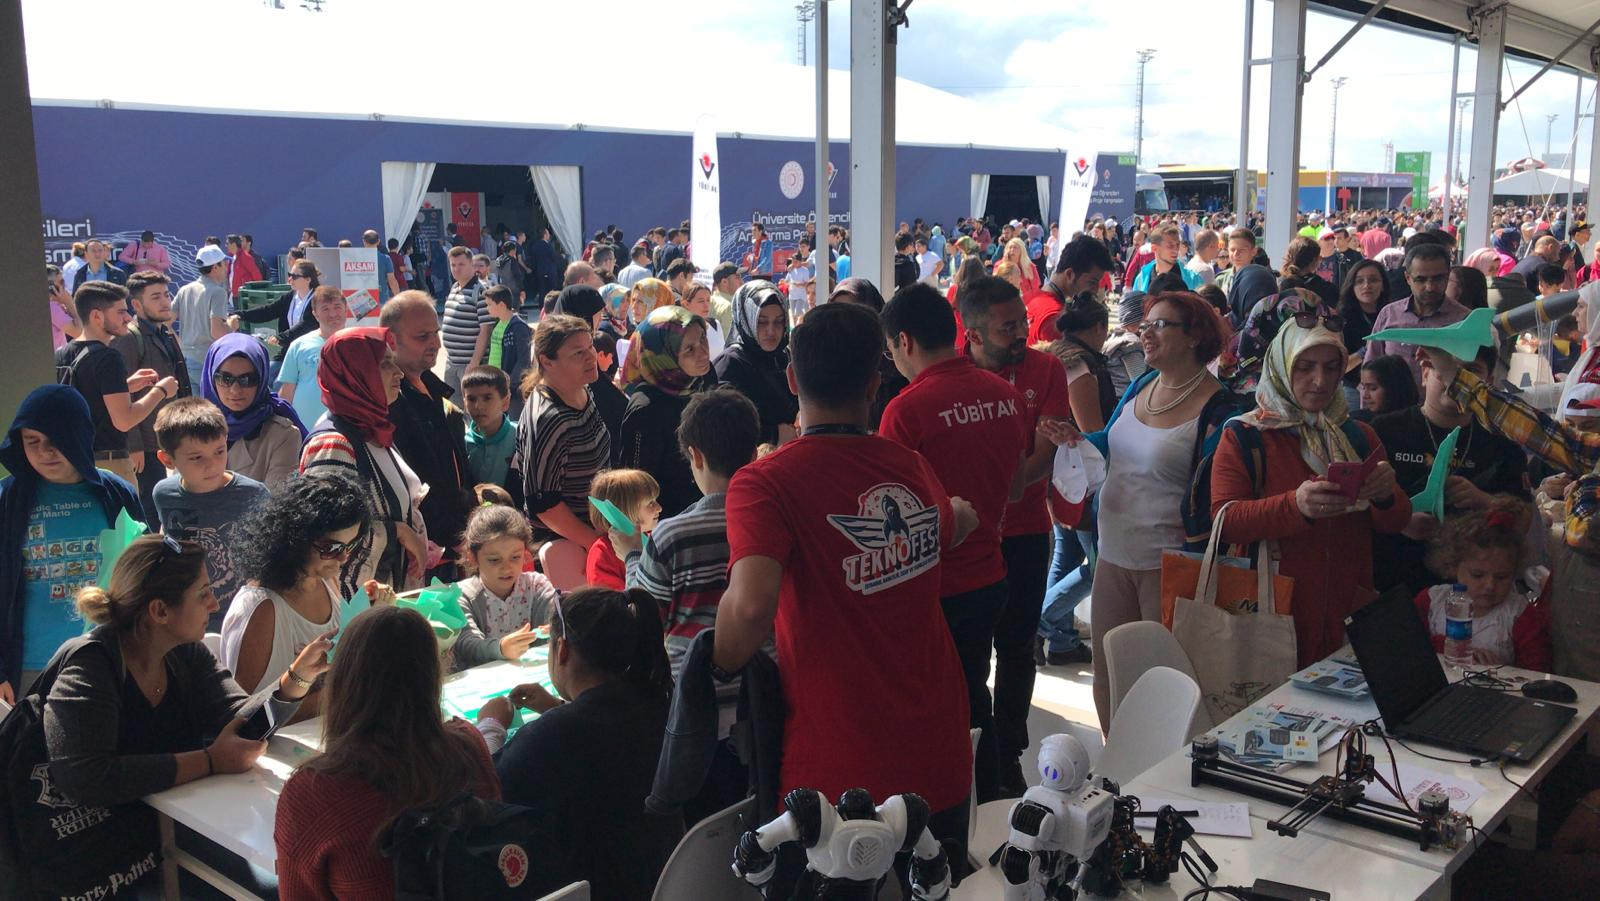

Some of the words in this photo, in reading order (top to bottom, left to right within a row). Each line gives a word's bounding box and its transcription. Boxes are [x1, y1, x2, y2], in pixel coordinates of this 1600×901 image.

[752, 212, 806, 224] Üniversite
[43, 219, 92, 237] ileri
[939, 399, 1018, 427] TÜBİTAK
[1395, 452, 1424, 463] SOLO
[53, 502, 80, 510] Table
[82, 501, 92, 509] of
[846, 525, 938, 582] TEKNOFES
